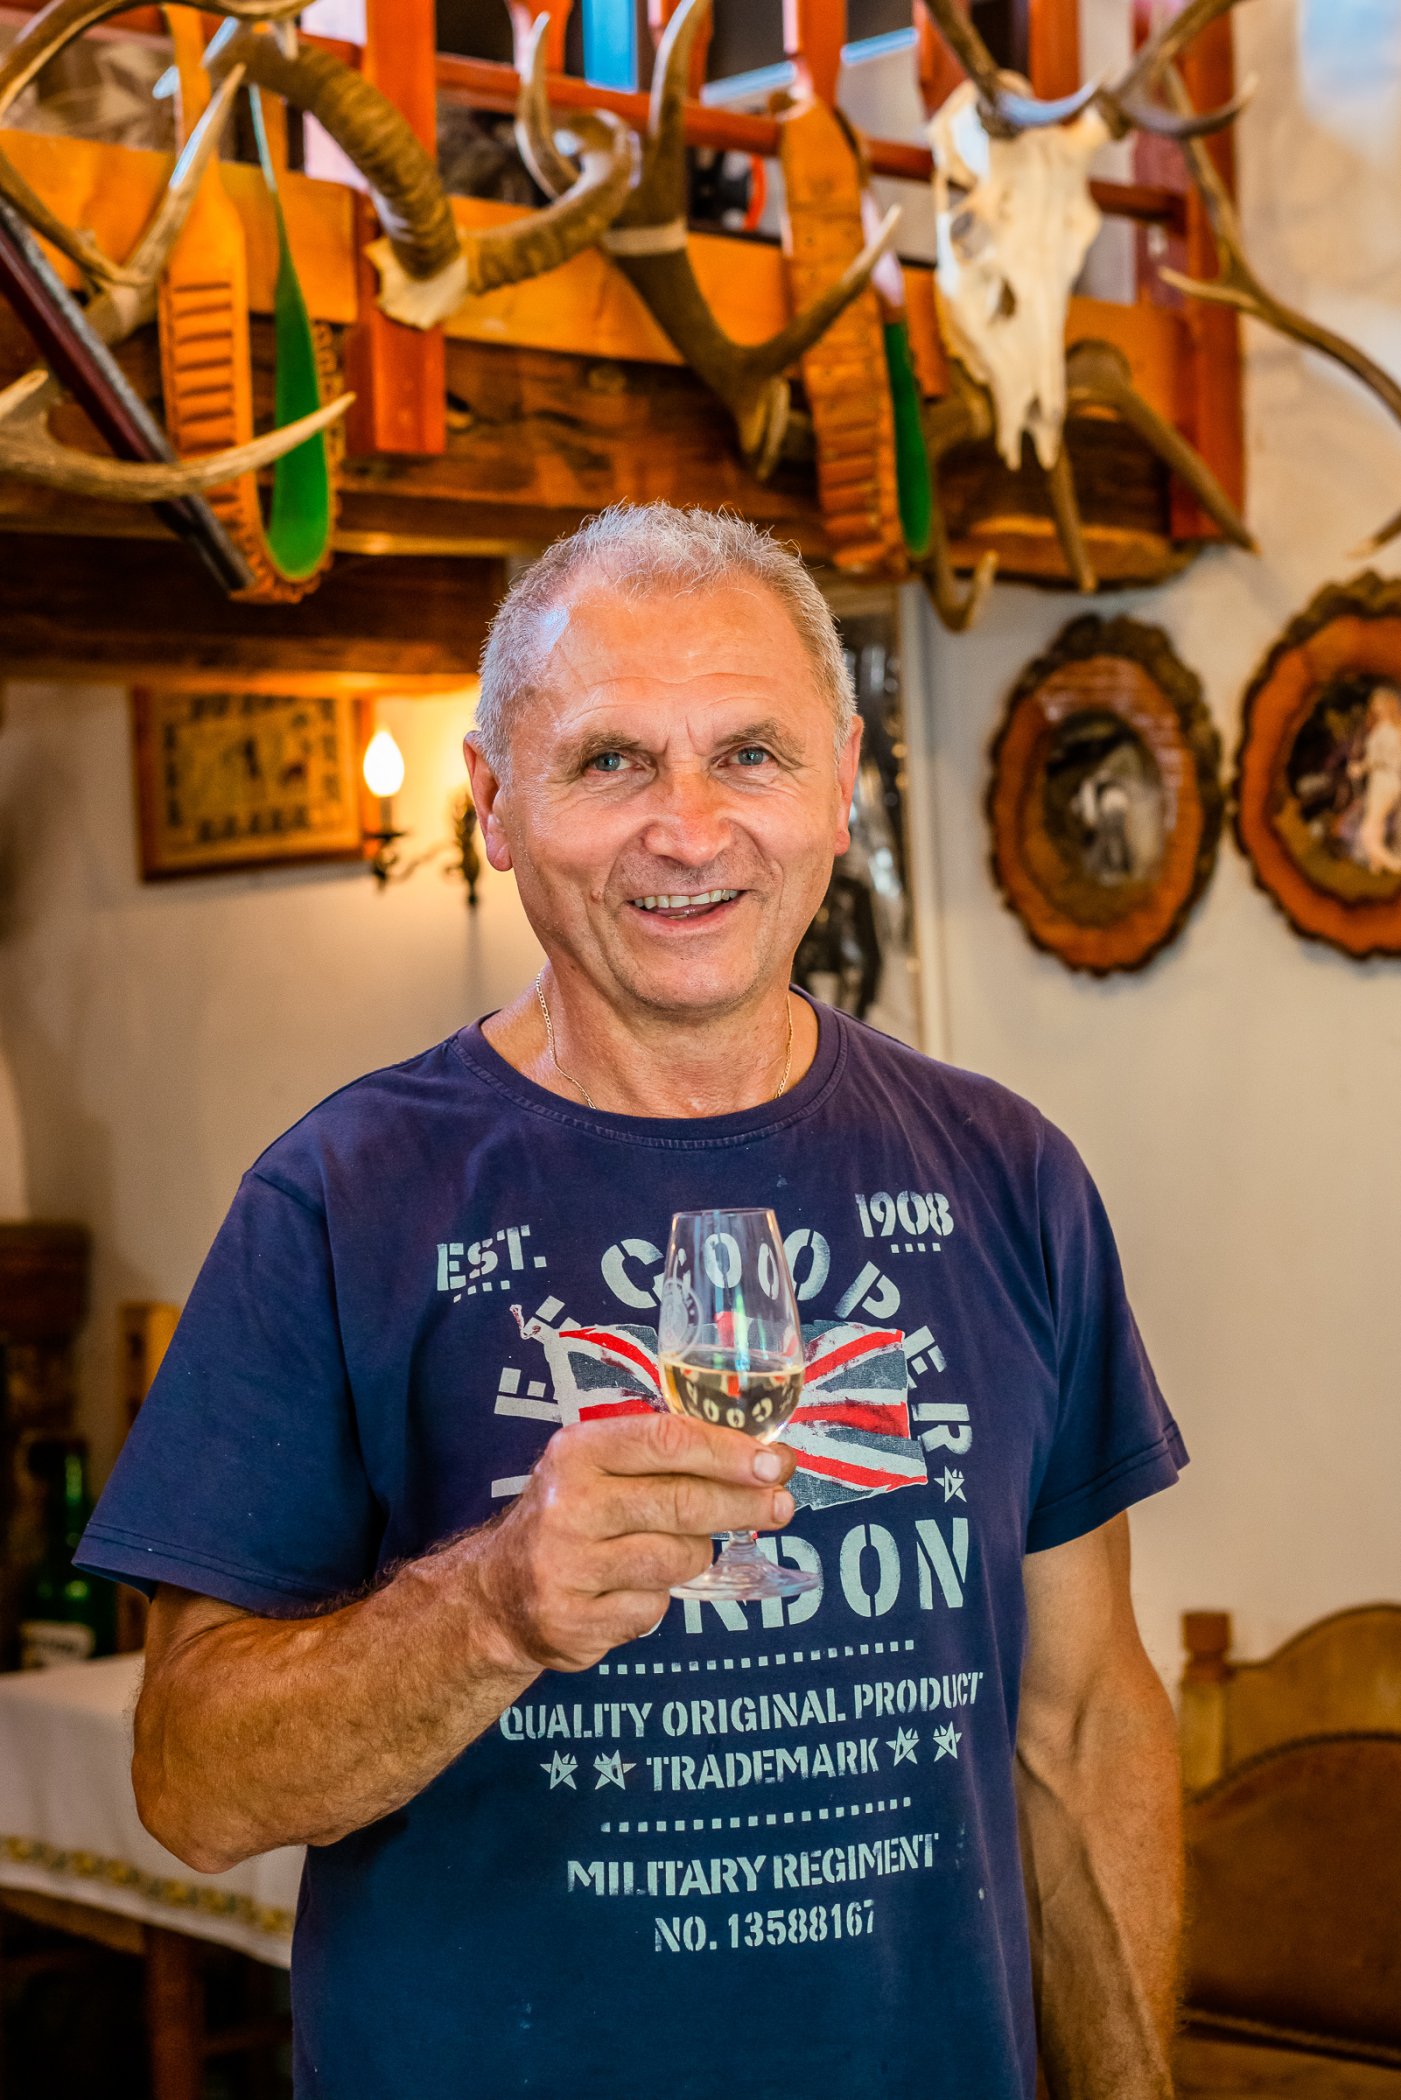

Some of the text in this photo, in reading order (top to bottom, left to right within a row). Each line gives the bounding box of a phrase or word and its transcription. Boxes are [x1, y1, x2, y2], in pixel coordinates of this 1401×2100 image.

[855, 1191, 955, 1238] 1908
[437, 1225, 547, 1292] EST.
[638, 1518, 969, 1637] NDON
[500, 1672, 984, 1740] QUALITY ORIGINAL PRODUCT
[646, 1738, 880, 1791] TRADEMARK
[567, 1833, 939, 1897] MILITARY REGIMENT
[654, 1899, 875, 1953] NO. 13588167
